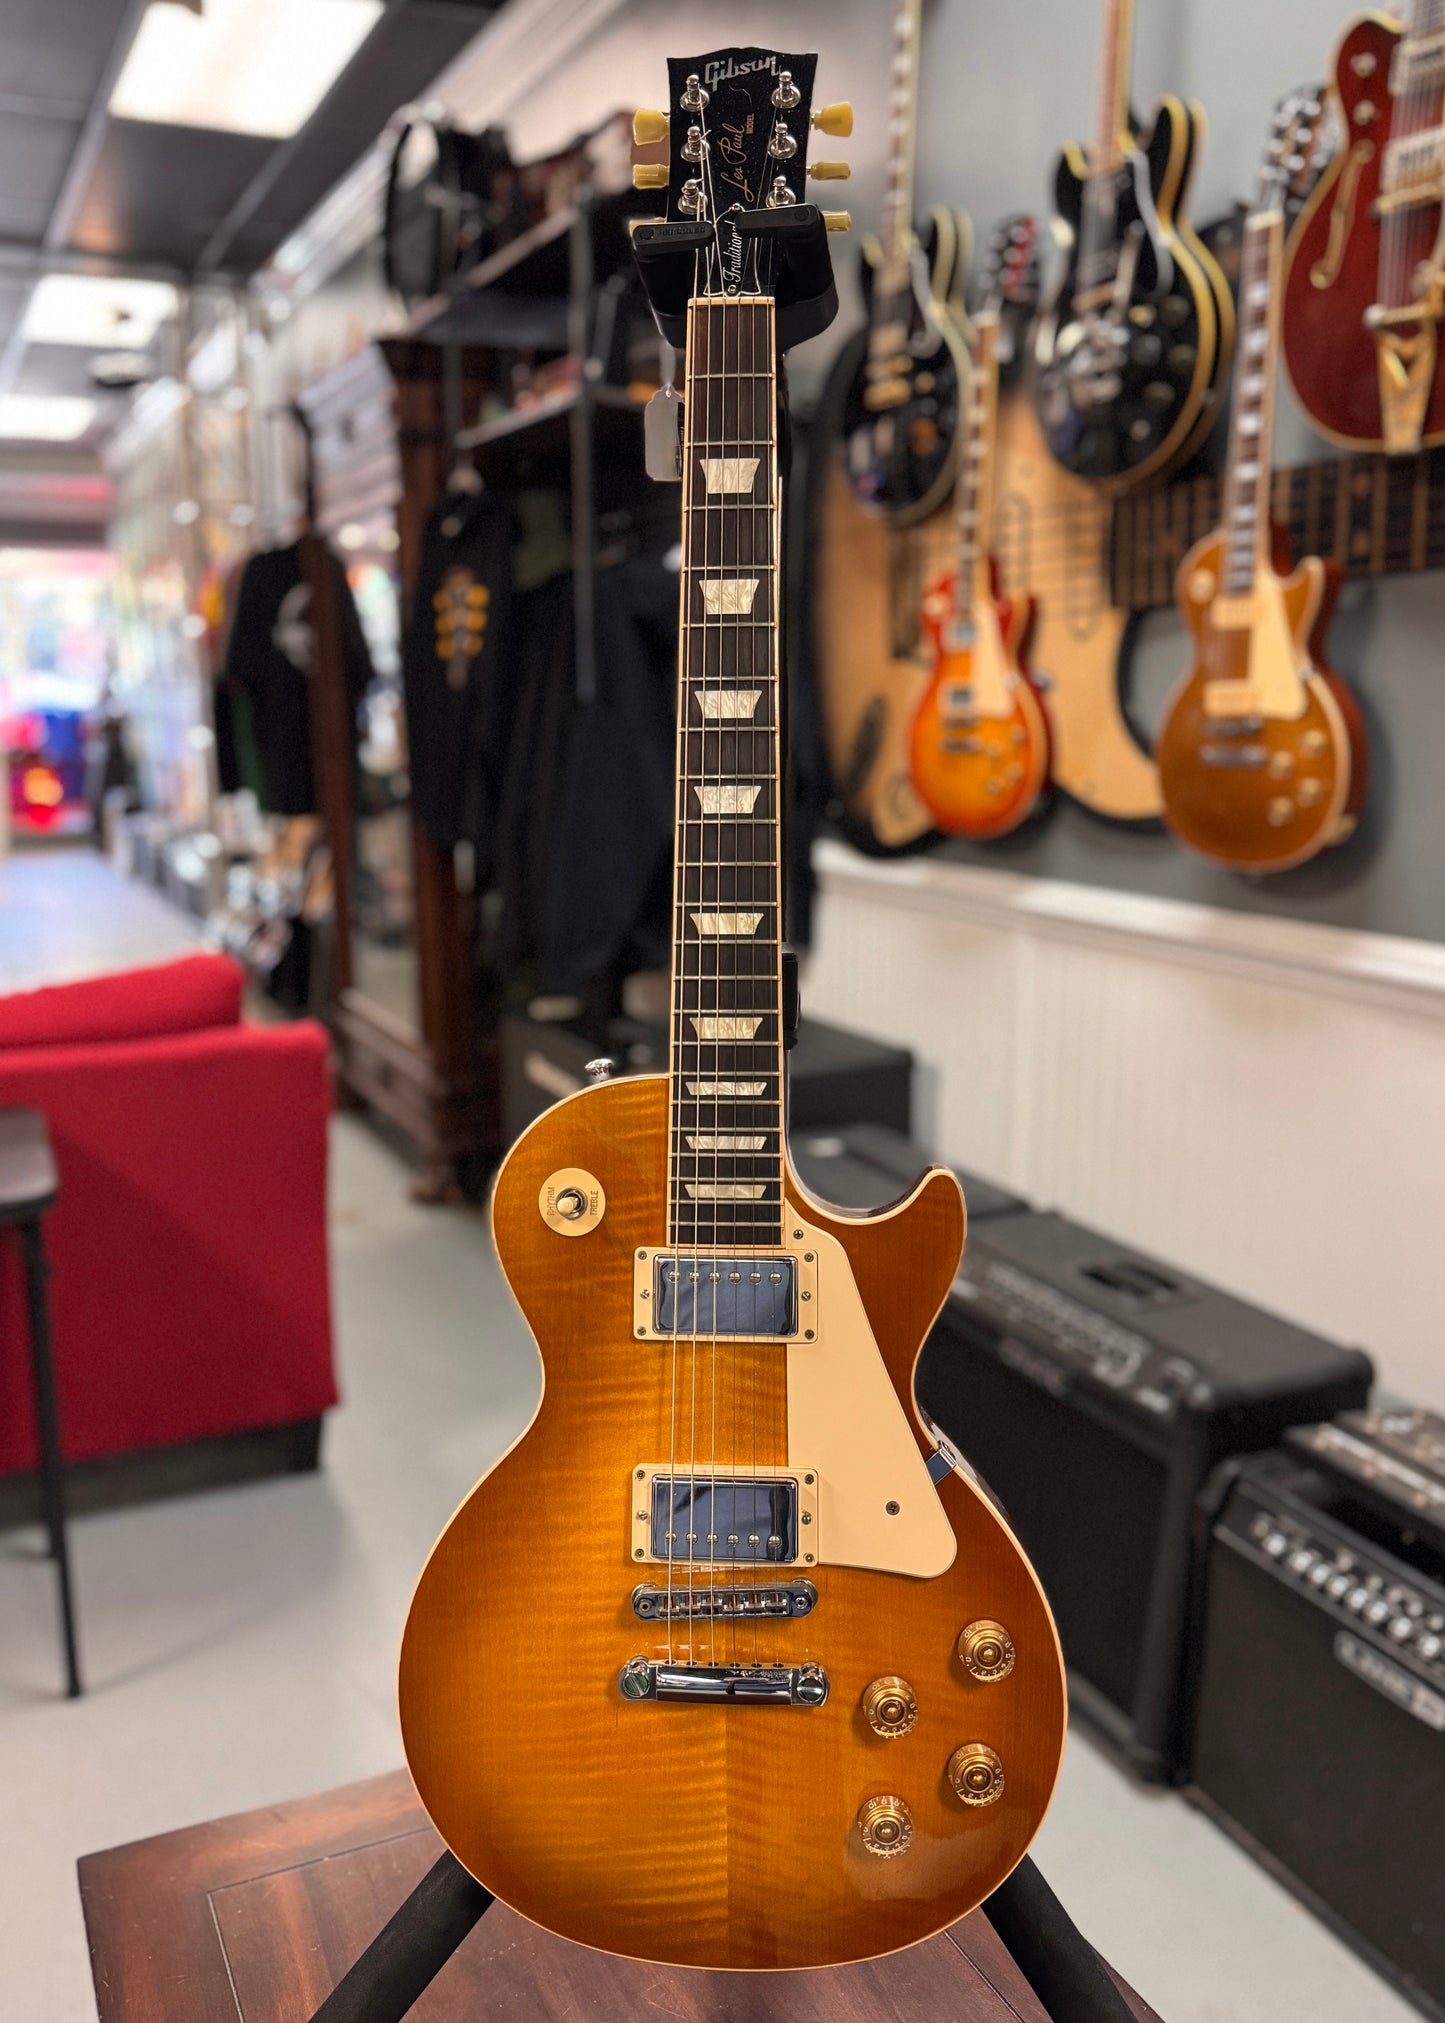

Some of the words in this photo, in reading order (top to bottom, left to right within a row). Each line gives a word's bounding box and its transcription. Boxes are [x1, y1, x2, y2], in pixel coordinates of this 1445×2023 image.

[704, 55, 781, 92] Gibson
[745, 112, 755, 135] MODEL
[717, 122, 748, 165] Paul
[720, 166, 755, 202] Les
[547, 1187, 555, 1216] RHYTHM
[590, 1190, 599, 1216] TREBLE
